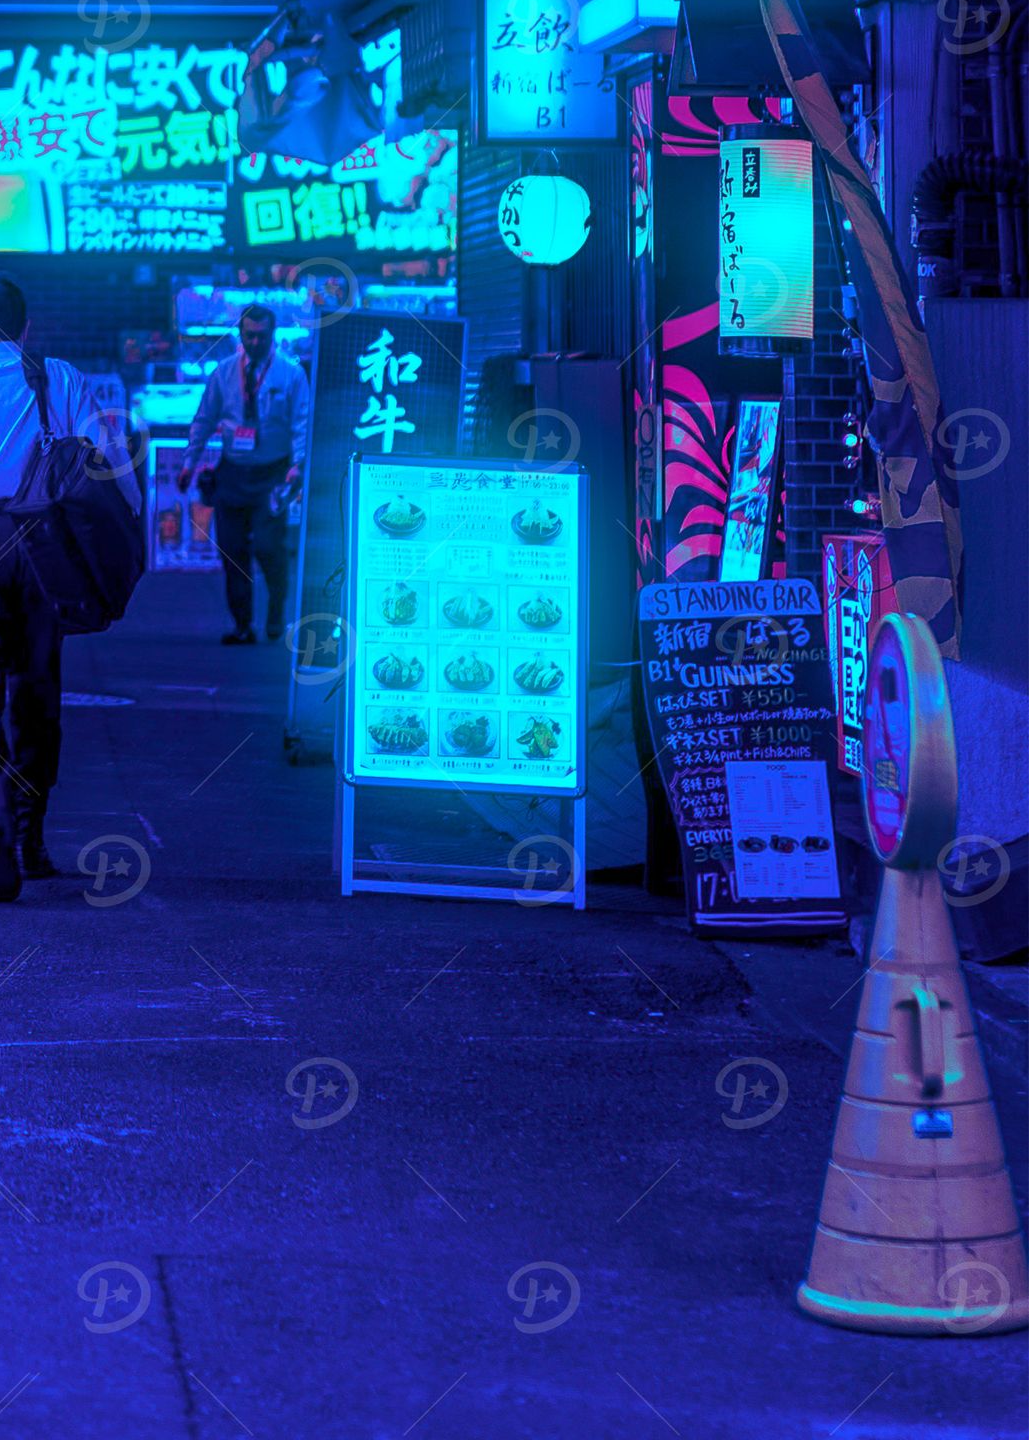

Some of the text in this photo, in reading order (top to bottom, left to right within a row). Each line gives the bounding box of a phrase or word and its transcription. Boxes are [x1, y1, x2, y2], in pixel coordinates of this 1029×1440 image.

[536, 104, 568, 130] B1
[352, 327, 423, 454] 和牛
[654, 583, 815, 616] STANDING BAR
[654, 619, 713, 656] 新宿
[679, 662, 797, 689] GUINNESS
